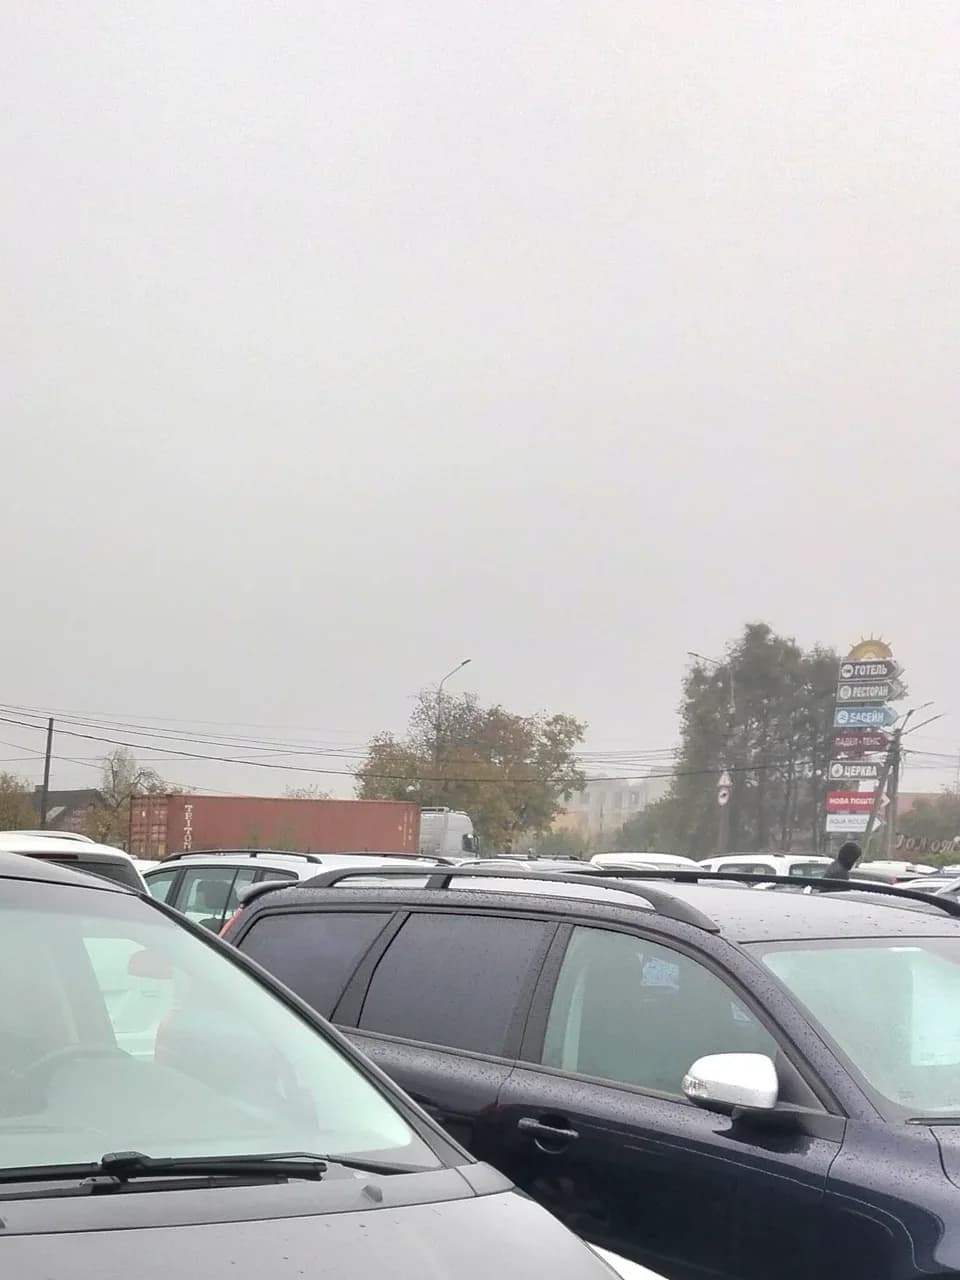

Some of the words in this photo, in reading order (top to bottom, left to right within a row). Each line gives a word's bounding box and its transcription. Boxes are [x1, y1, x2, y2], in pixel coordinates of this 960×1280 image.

[854, 664, 888, 675] ГОТЕЛЬ
[852, 685, 889, 697] РЕСТОРАН
[848, 710, 885, 723] БАСЕЙН
[844, 765, 878, 777] ЦЕРКВА
[829, 797, 849, 805] НОВА
[183, 804, 193, 849] TRITON
